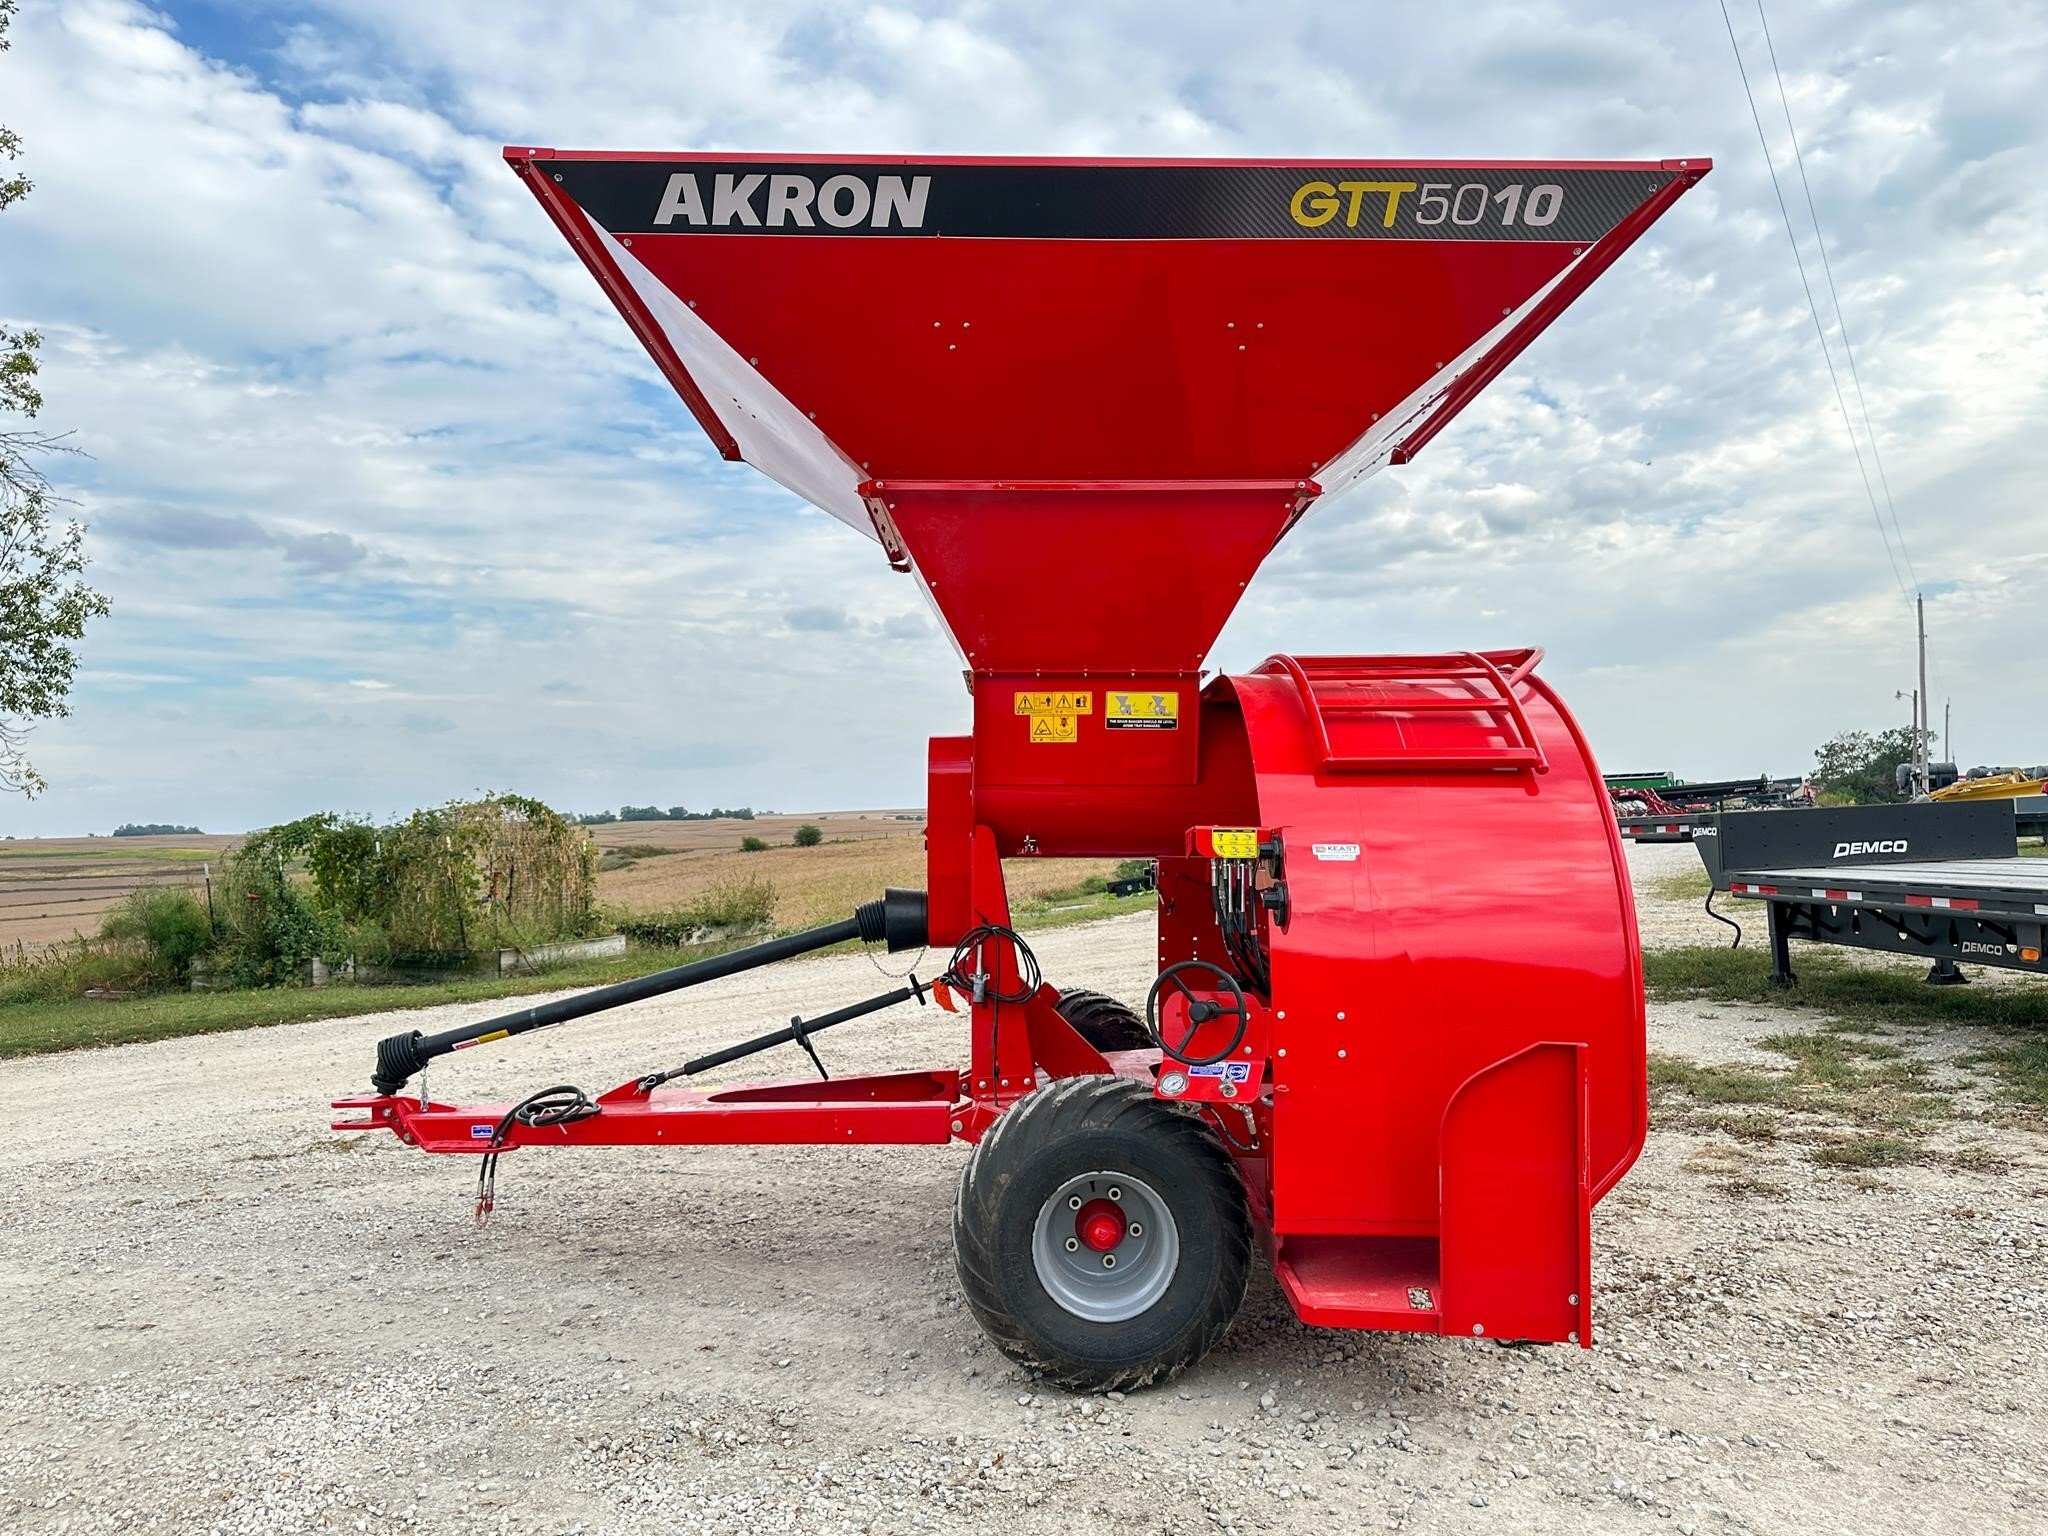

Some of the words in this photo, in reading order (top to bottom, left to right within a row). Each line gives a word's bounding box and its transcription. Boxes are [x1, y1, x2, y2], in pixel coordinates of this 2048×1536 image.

[653, 173, 932, 228] AKRON
[1290, 181, 1564, 228] GTT5010
[1692, 827, 1717, 838] DEMCO
[1832, 839, 1908, 858] DEMCO
[1961, 941, 2003, 956] DEMCO
